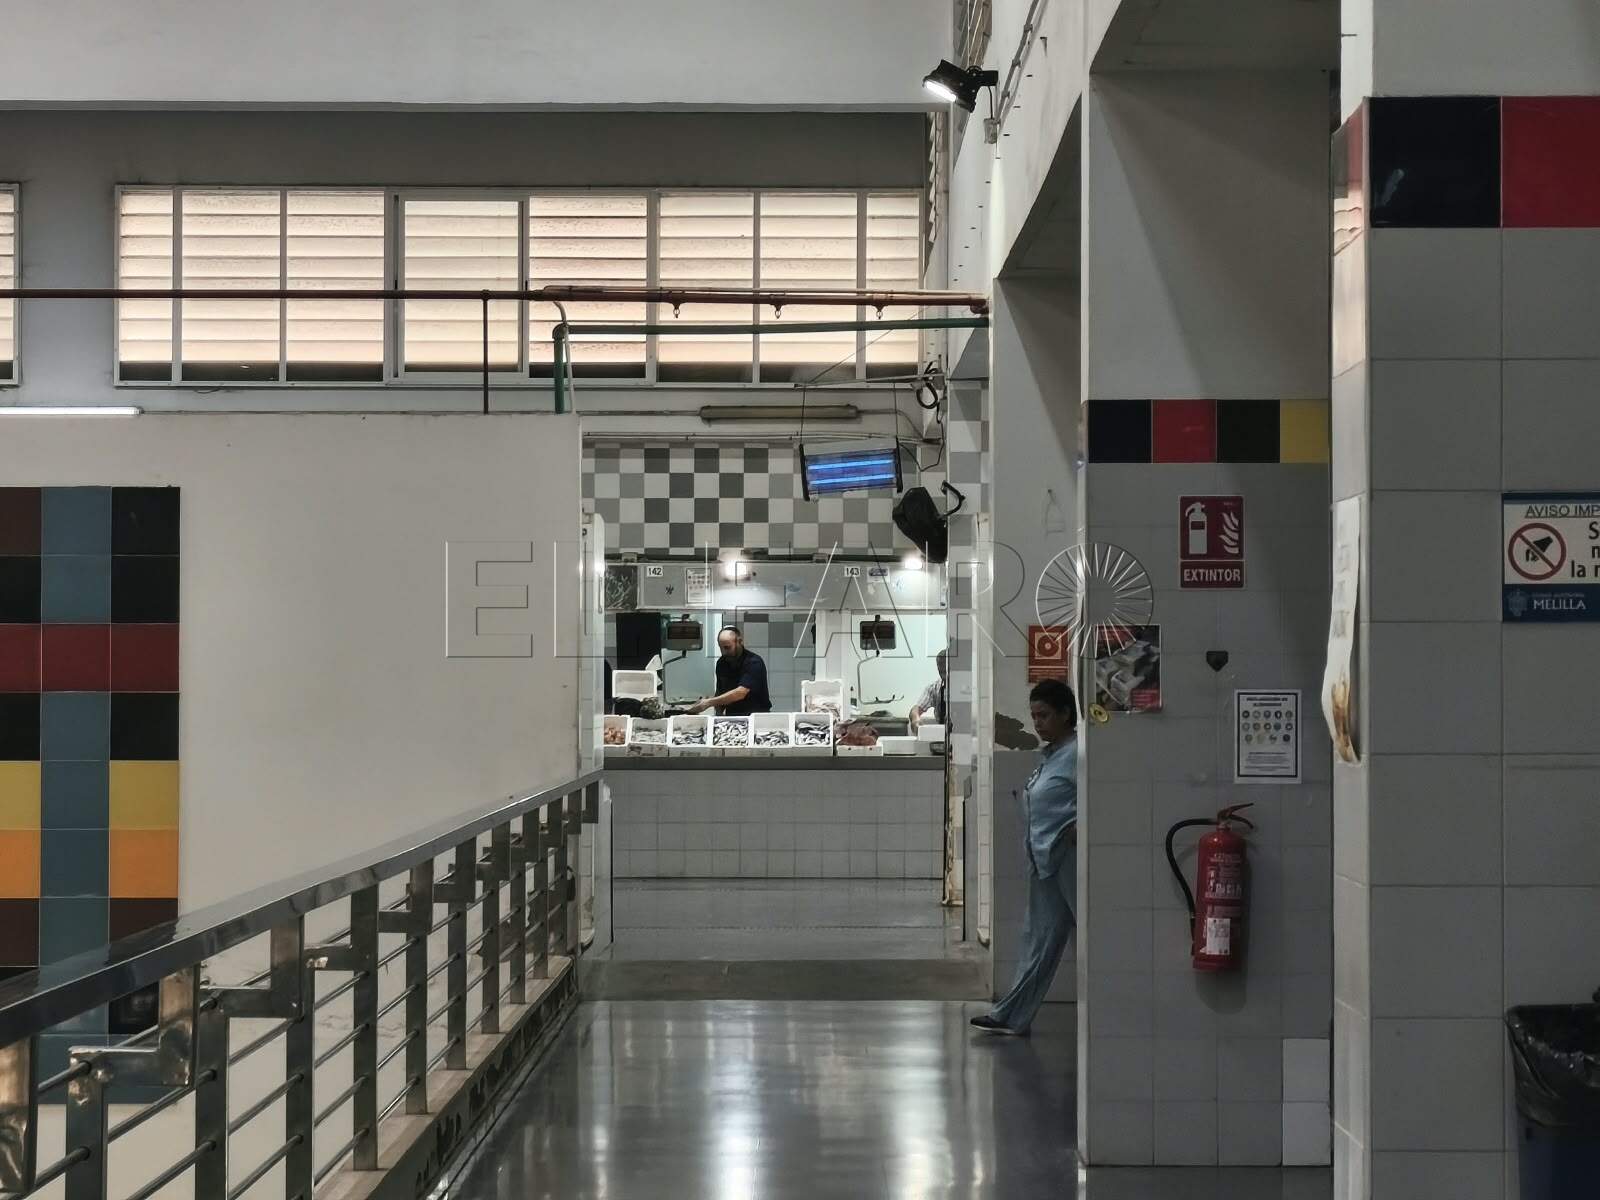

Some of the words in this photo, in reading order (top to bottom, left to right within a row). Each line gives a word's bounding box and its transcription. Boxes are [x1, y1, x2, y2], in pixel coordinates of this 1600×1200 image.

[1525, 505, 1570, 518] AVISO
[648, 567, 663, 576] 142
[846, 567, 860, 576] 143
[1571, 559, 1586, 578] la
[1183, 568, 1241, 582] EXTINTOR
[1533, 599, 1587, 610] MELILLA
